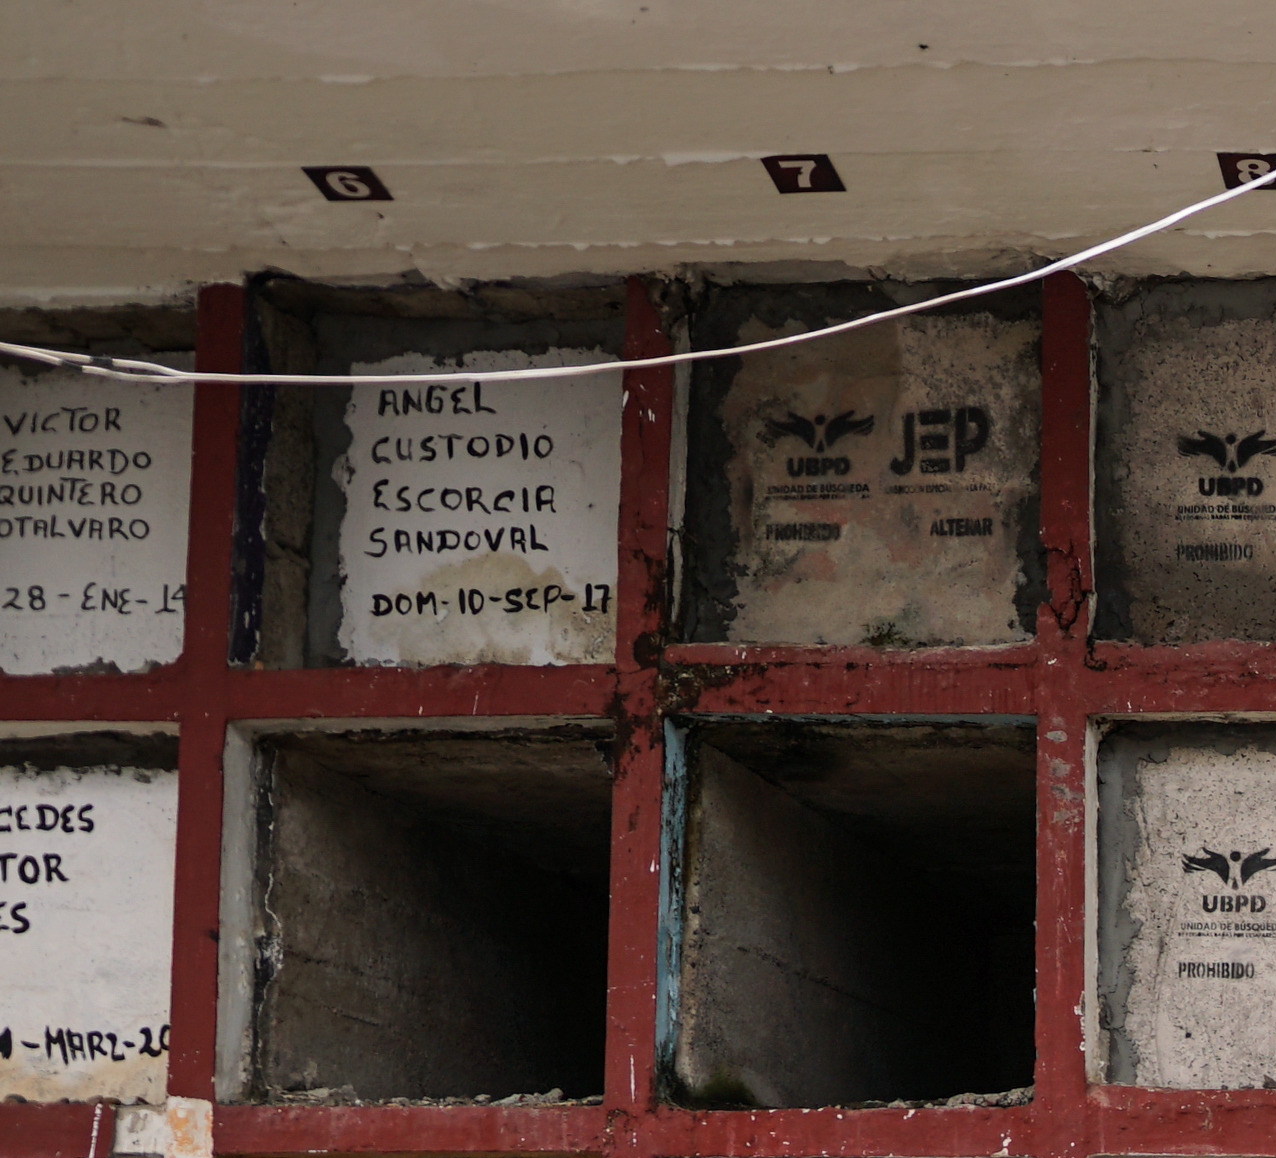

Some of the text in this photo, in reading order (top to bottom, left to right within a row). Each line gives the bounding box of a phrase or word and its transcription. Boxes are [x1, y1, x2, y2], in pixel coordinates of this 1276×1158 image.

[325, 172, 371, 199] 6
[778, 160, 817, 188] 7
[1235, 159, 1272, 186] 8
[377, 381, 497, 417] ANGEL
[2, 406, 121, 437] VICTOR
[371, 432, 554, 465] CUSTODIO
[889, 407, 991, 476] JEP
[1, 447, 152, 476] EDUARDO
[372, 478, 557, 515] ESCORCIA
[363, 523, 549, 558] SANDOVAL
[1203, 895, 1266, 913] UBPD
[1178, 962, 1255, 979] PROHIBIDO
